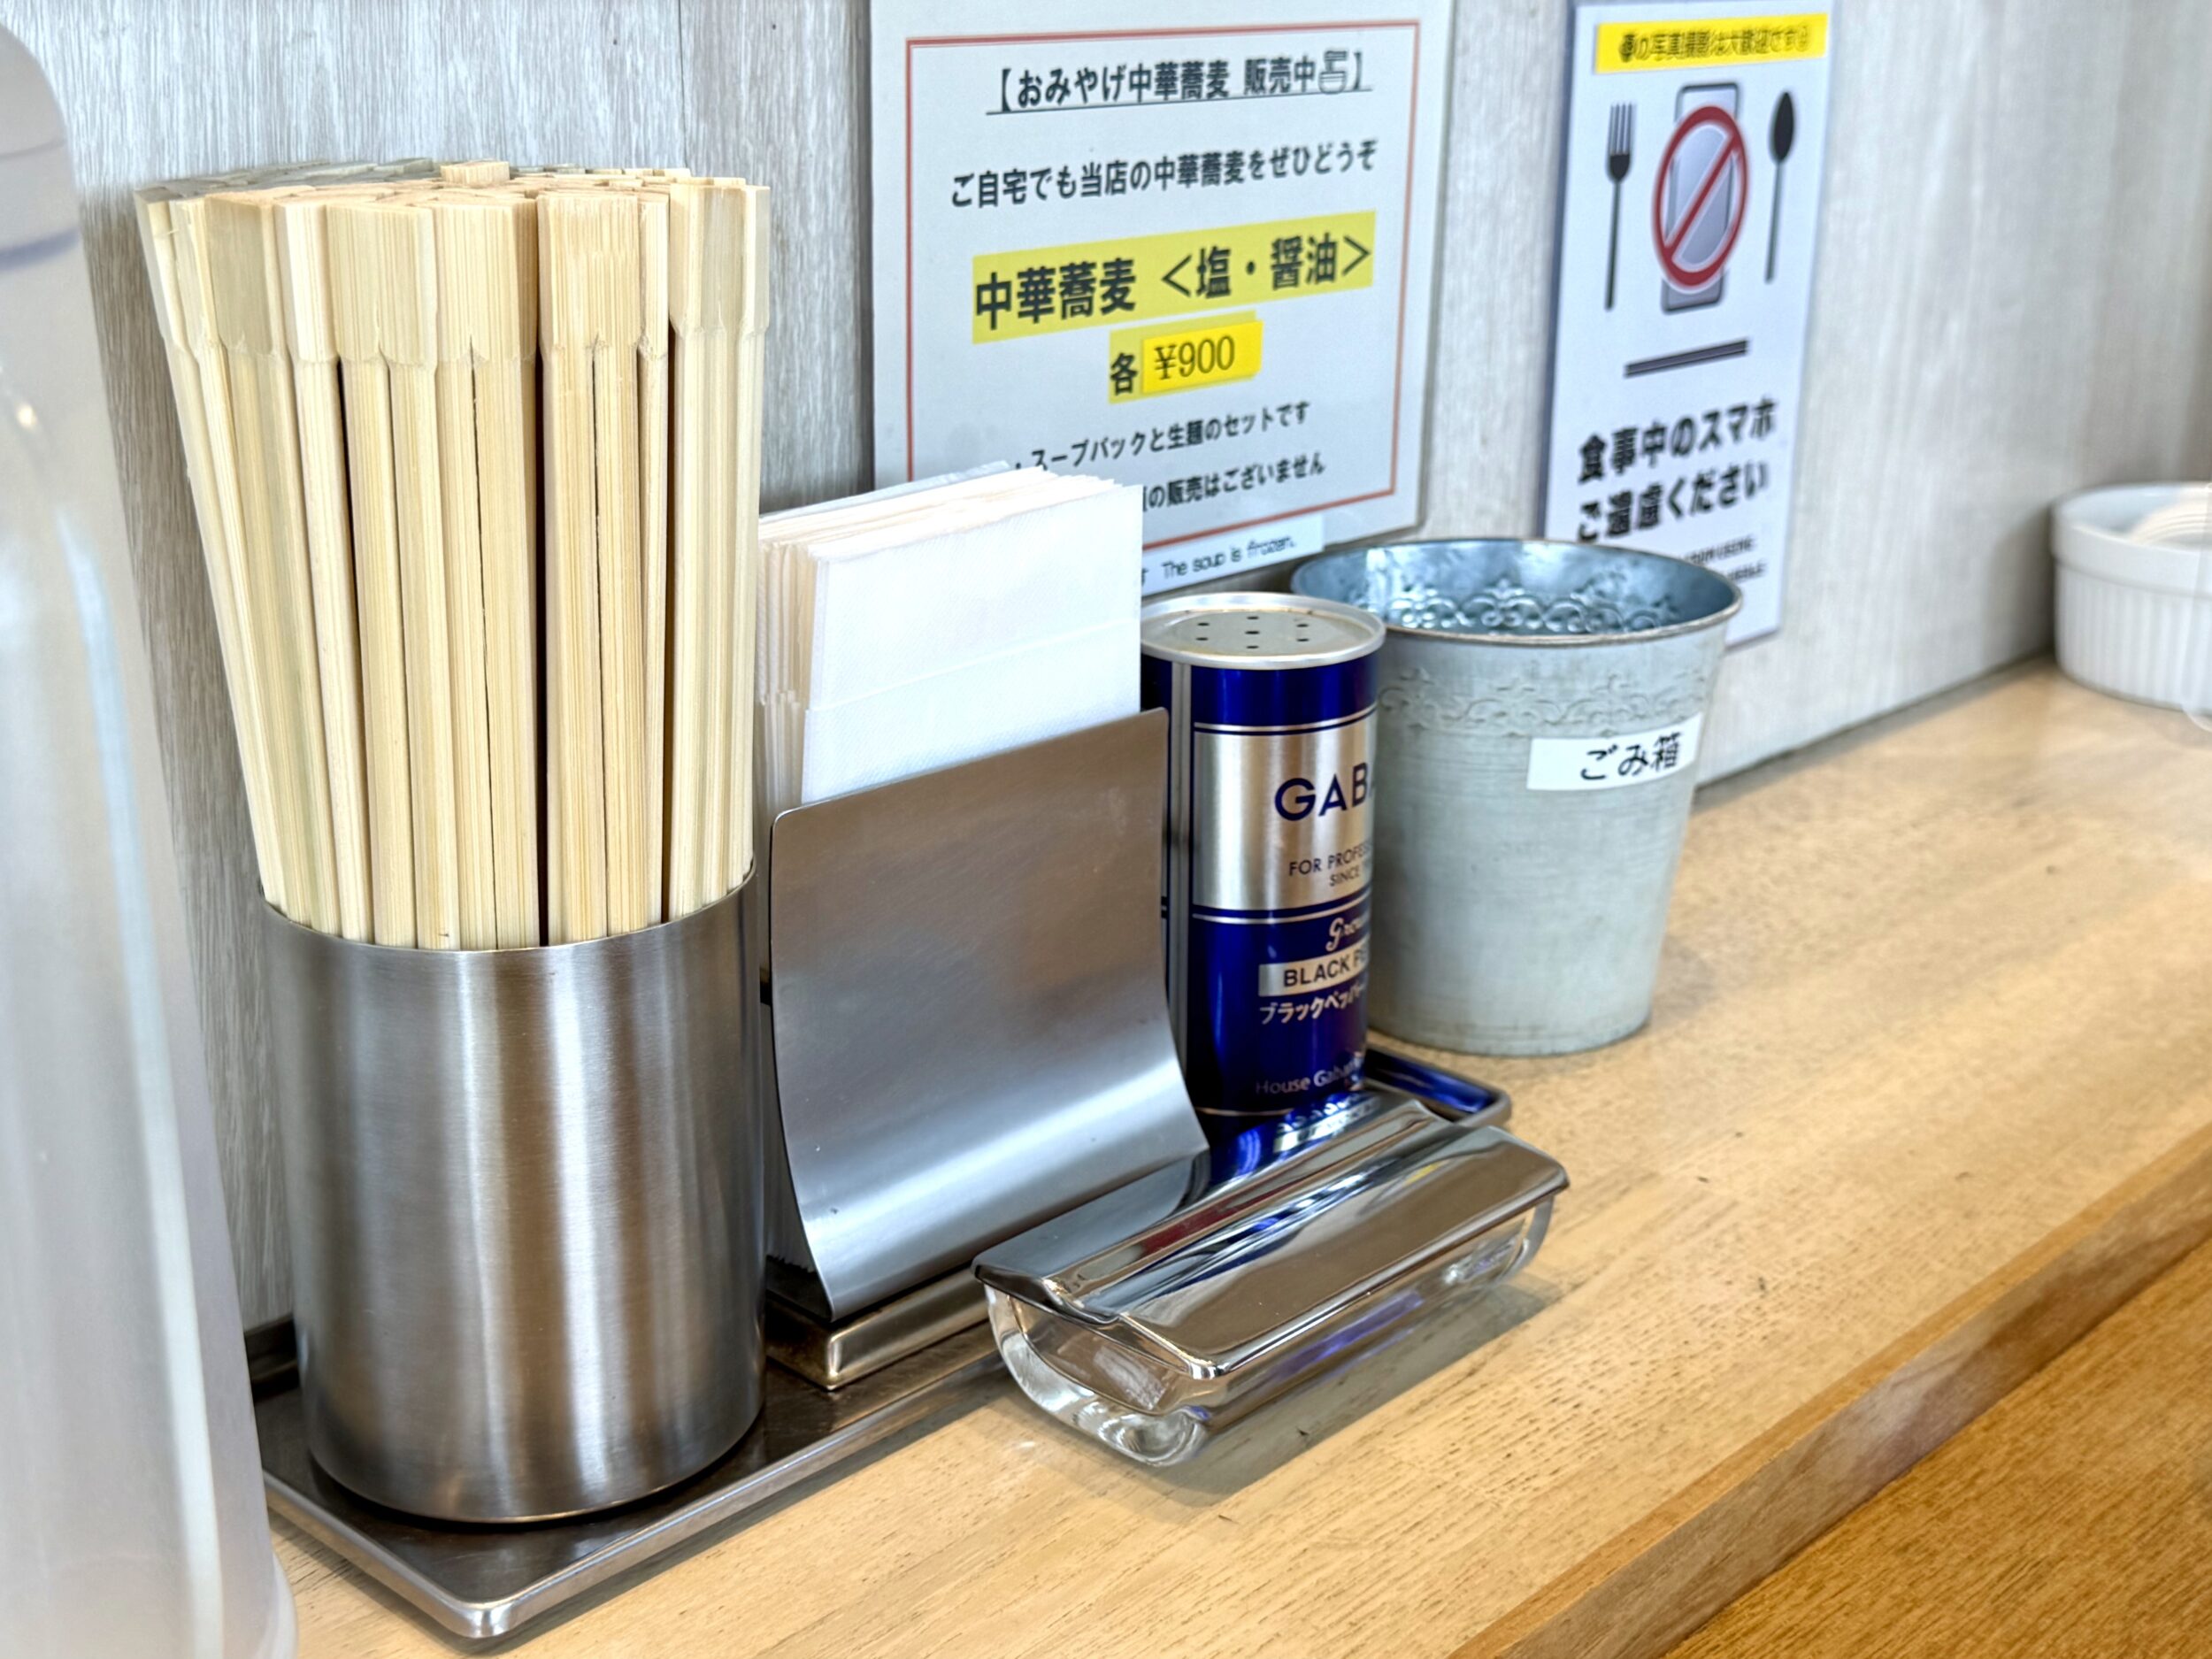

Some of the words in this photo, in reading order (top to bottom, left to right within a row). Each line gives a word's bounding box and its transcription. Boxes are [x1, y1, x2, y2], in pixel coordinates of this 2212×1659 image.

[951, 138, 1379, 210] ご自宅でも当店の中華蕎麦をぜひどうぞ
[975, 257, 1137, 331] 中華蕎麦
[1110, 351, 1140, 396] 各
[1153, 334, 1237, 381] ¥900
[1578, 394, 1777, 486] 食事中のスマホ
[1141, 451, 1326, 513] の販売はございません
[1162, 557, 1188, 580] The
[1192, 550, 1227, 574] soup
[1232, 544, 1242, 564] is
[1579, 731, 1682, 780] ごみ箱
[1274, 761, 1369, 822] GAB
[1288, 857, 1322, 877] FOR
[1283, 955, 1351, 987] BLACK
[1255, 1077, 1311, 1095] House
